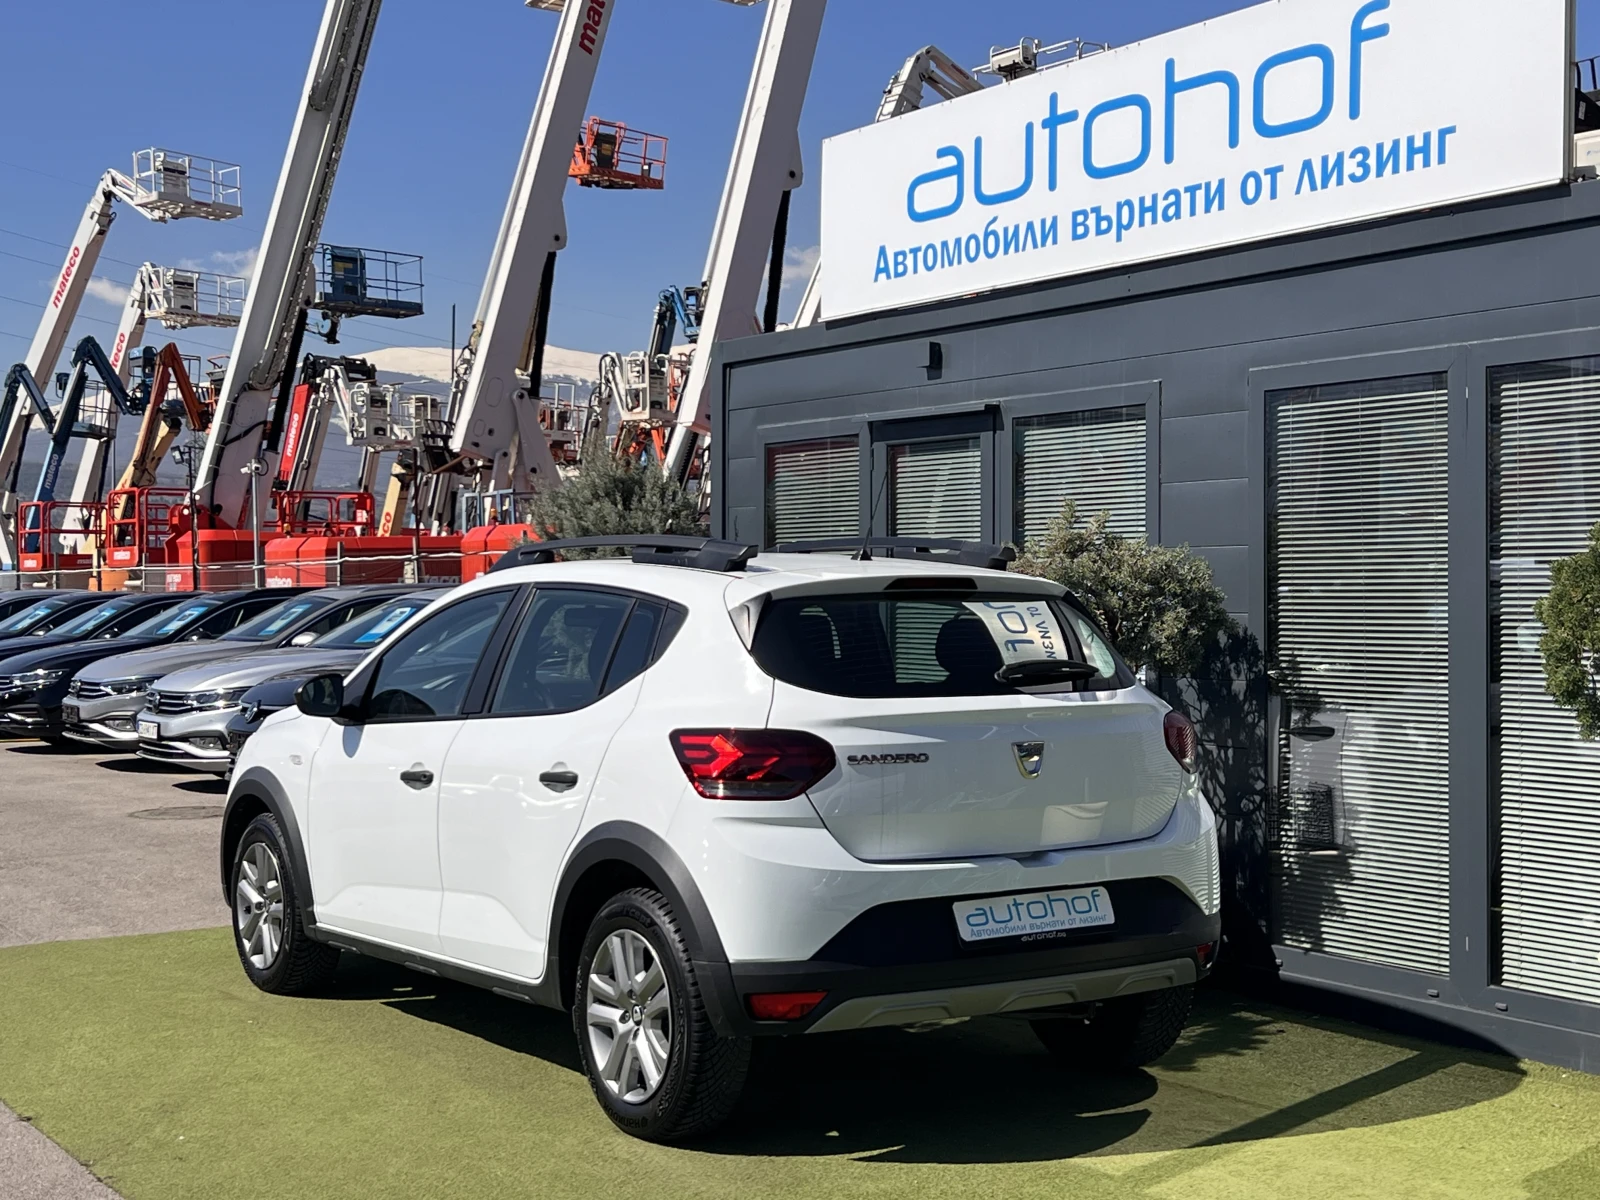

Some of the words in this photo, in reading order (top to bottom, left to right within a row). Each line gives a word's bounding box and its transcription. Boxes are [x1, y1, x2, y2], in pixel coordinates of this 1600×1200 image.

[907, 0, 1390, 223] autohof
[873, 215, 1058, 282] Автомобили
[1071, 178, 1226, 243] върнати
[1240, 165, 1284, 205] от
[1295, 125, 1457, 195] лизинг
[52, 246, 80, 308] mateco
[286, 413, 299, 457] mateco
[44, 454, 59, 489] mateco
[847, 753, 929, 765] SANDERO
[966, 889, 1101, 927] autohof
[970, 924, 1027, 938] Автомобили
[1029, 919, 1066, 932] върнати
[1068, 917, 1077, 926] от
[1079, 914, 1108, 925] лизинг
